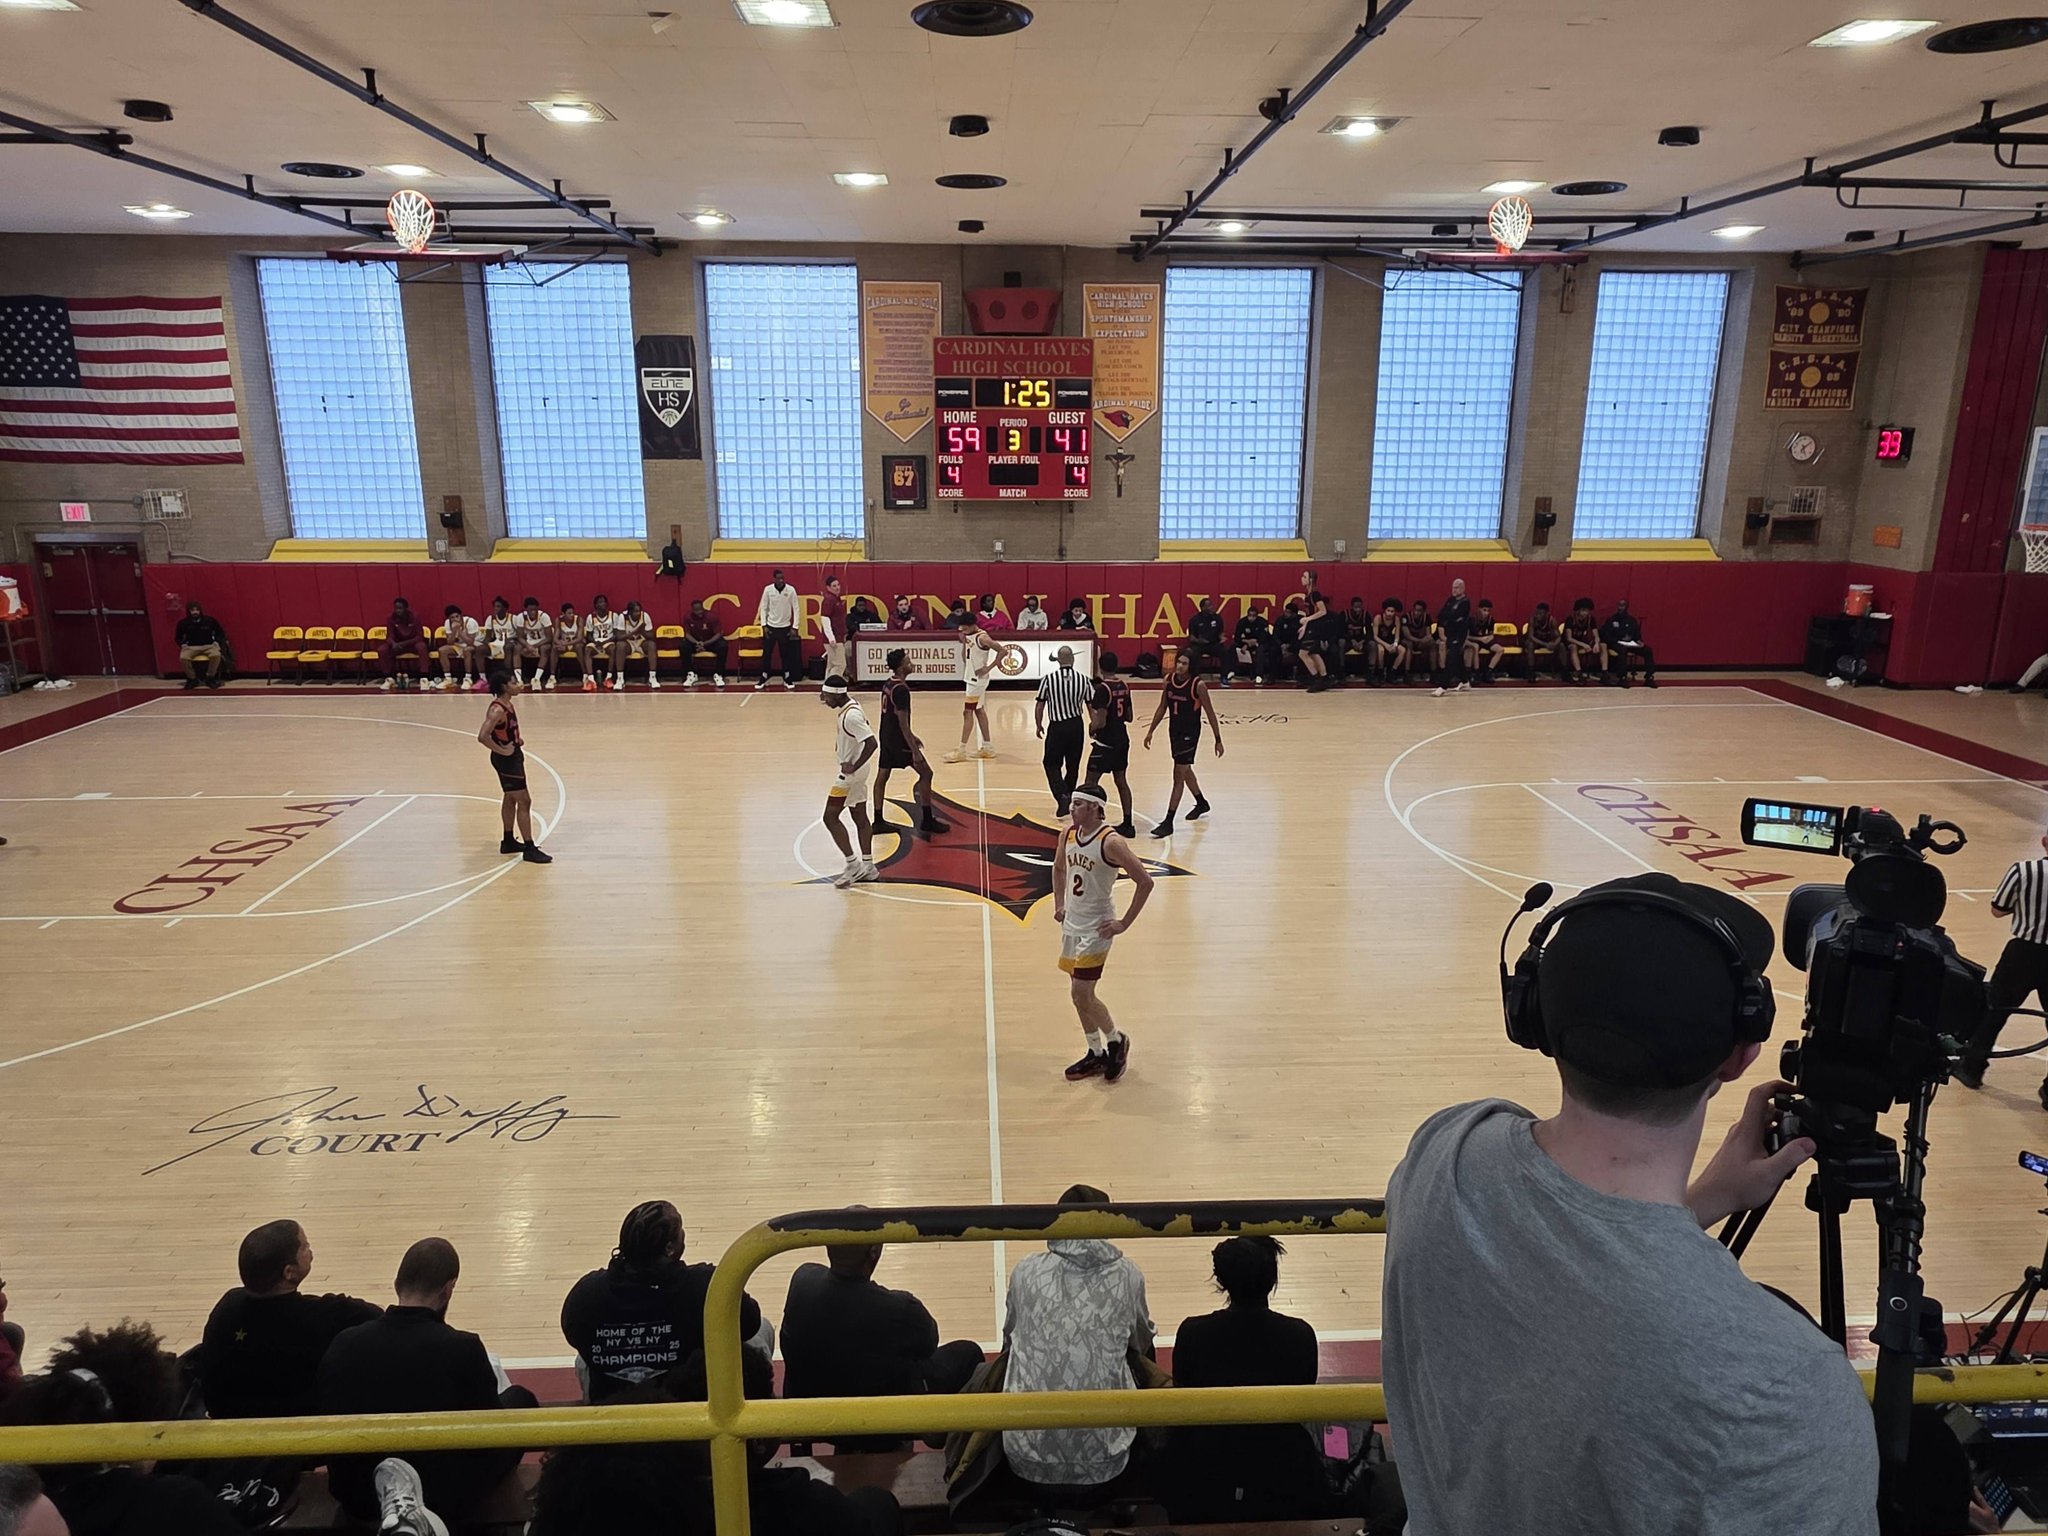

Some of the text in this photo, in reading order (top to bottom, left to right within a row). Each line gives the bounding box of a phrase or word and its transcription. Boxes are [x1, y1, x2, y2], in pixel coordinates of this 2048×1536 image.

[1090, 292, 1154, 300] CARDINAL HAYES
[1091, 315, 1153, 323] SPORTSMANSHIP
[1780, 324, 1855, 334] CITY CHAMPIONS
[1812, 334, 1858, 343] BASKETBALL
[936, 342, 1090, 357] CARDINAL HAYES
[953, 360, 1076, 376] HIGH SCHOOL
[651, 379, 684, 388] ELITE
[1004, 380, 1050, 407] 1:25
[1771, 388, 1848, 398] CITY CHAMPIONS
[658, 392, 680, 407] HS
[1094, 400, 1152, 411] ARDINAL PRIDE
[1767, 397, 1850, 407] VARSITY BASEBALL
[943, 411, 977, 424] HOME
[1000, 418, 1027, 427] PERIOD
[1048, 412, 1086, 424] GUEST
[948, 427, 980, 452] 59
[1008, 429, 1020, 451] 3
[1055, 429, 1086, 451] 41
[938, 455, 963, 464] FOULS
[988, 455, 1040, 465] PLAYER FOUL
[1064, 456, 1089, 465] FOULS
[947, 466, 959, 483] 4
[1073, 466, 1085, 483] 4
[938, 489, 963, 498] SCORE
[999, 489, 1026, 498] MATCH
[1064, 490, 1088, 498] SCORE
[64, 505, 87, 520] EXIT
[598, 630, 608, 639] 12
[868, 648, 955, 660] GO DINALS
[868, 665, 890, 674] THIS
[925, 664, 957, 674] HOUSE
[1117, 699, 1124, 718] 5
[1173, 701, 1179, 716] 1
[1577, 784, 1795, 891] CHSAA
[113, 796, 366, 914] CHSAA
[1067, 853, 1095, 872] HAYES
[1073, 874, 1084, 897] 2
[250, 1133, 442, 1157] COURT
[596, 1325, 672, 1338] HOME OF THE
[606, 1336, 661, 1347] NY VS NY
[669, 1340, 680, 1350] 25
[592, 1344, 602, 1353] 20
[592, 1352, 678, 1366] CHAMPIONS
